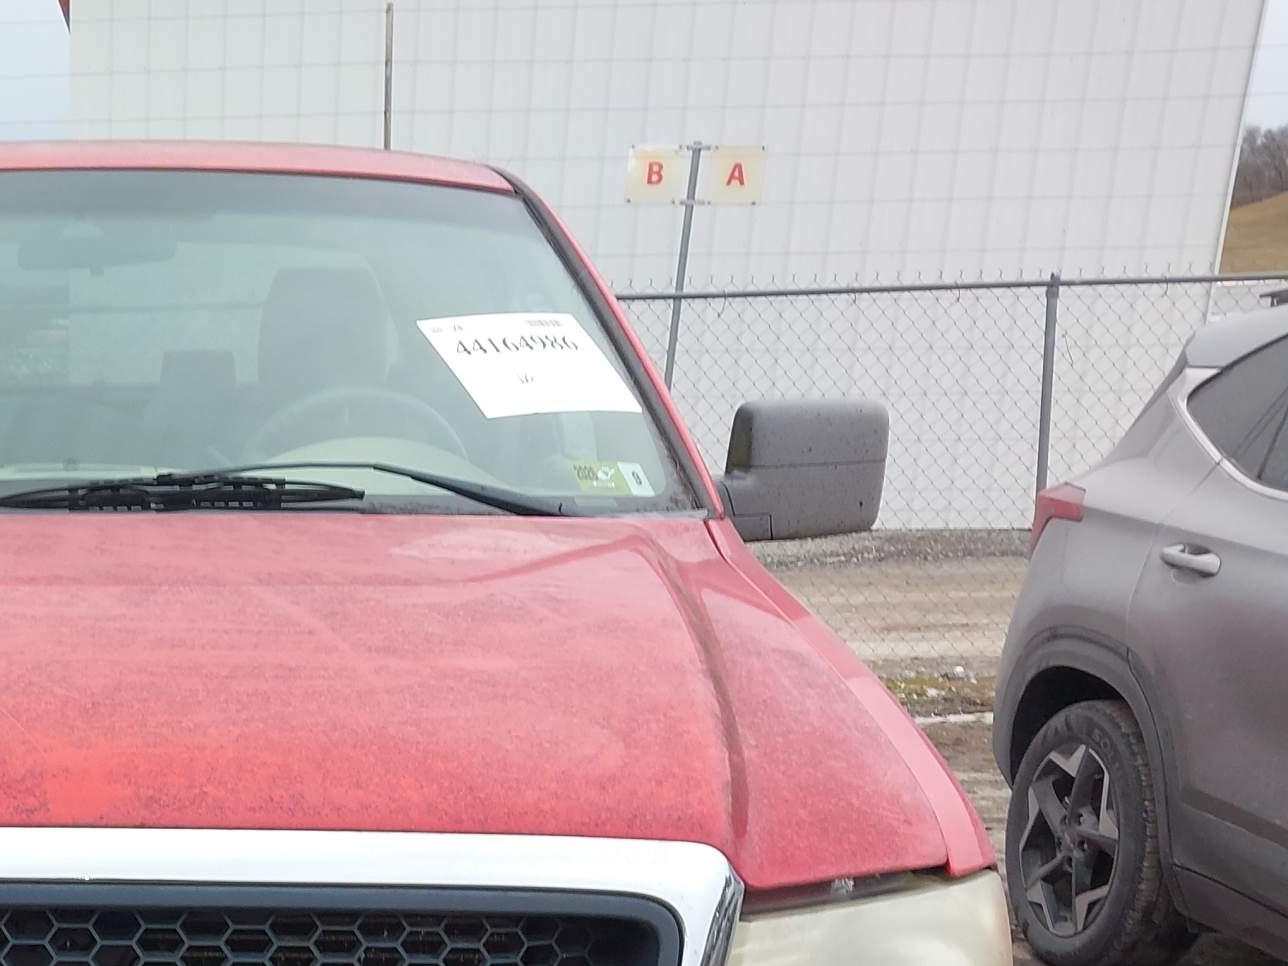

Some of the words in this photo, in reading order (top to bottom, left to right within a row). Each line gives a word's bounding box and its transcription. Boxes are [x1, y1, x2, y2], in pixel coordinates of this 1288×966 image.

[646, 161, 664, 185] B
[725, 162, 745, 187] A
[456, 335, 579, 356] 44164986
